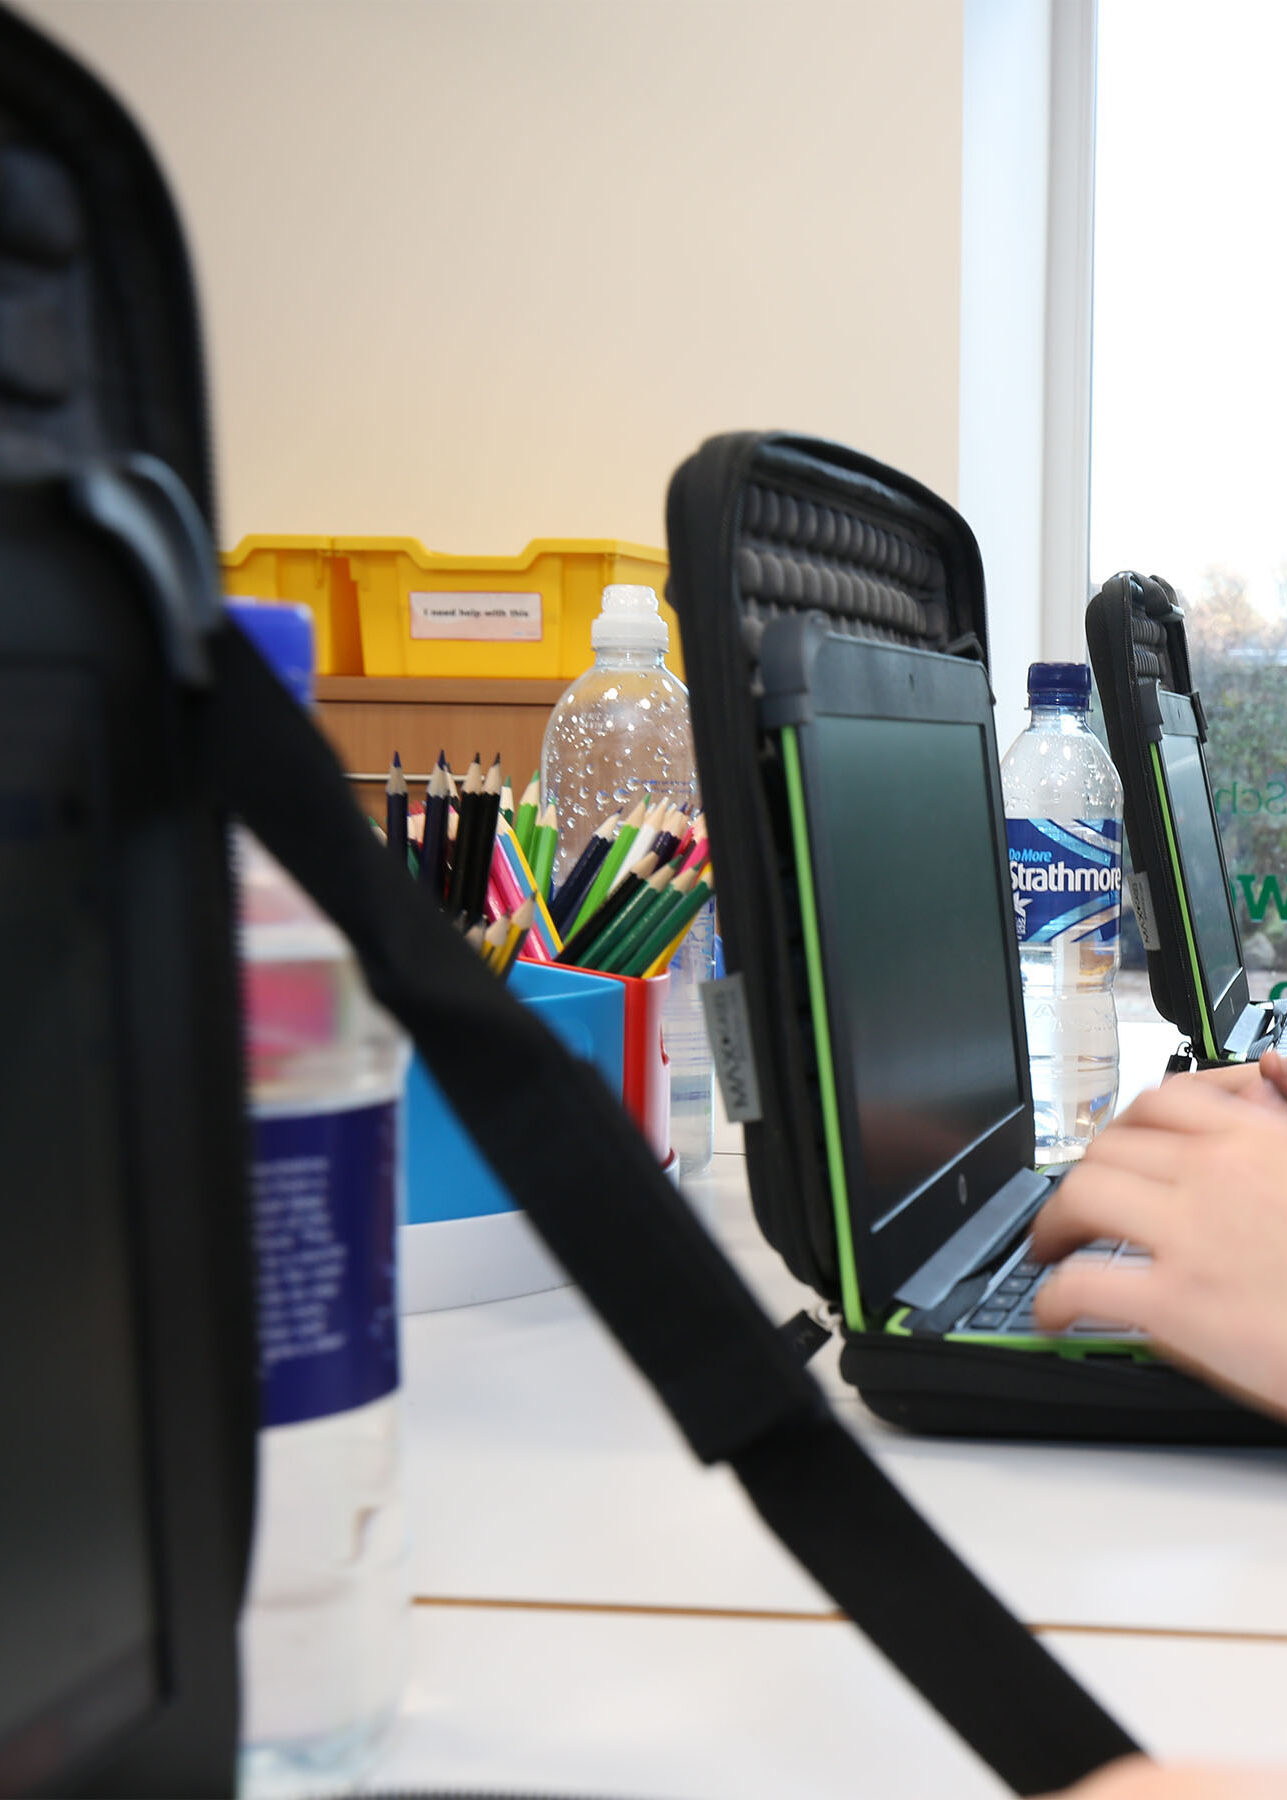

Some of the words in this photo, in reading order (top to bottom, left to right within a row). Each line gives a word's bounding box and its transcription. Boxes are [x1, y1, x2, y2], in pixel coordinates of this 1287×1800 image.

[460, 608, 481, 618] help
[484, 609, 506, 617] with
[509, 609, 529, 617] this
[1008, 847, 1021, 861] Do
[1021, 848, 1053, 863] More
[1009, 860, 1122, 892] Strathmore
